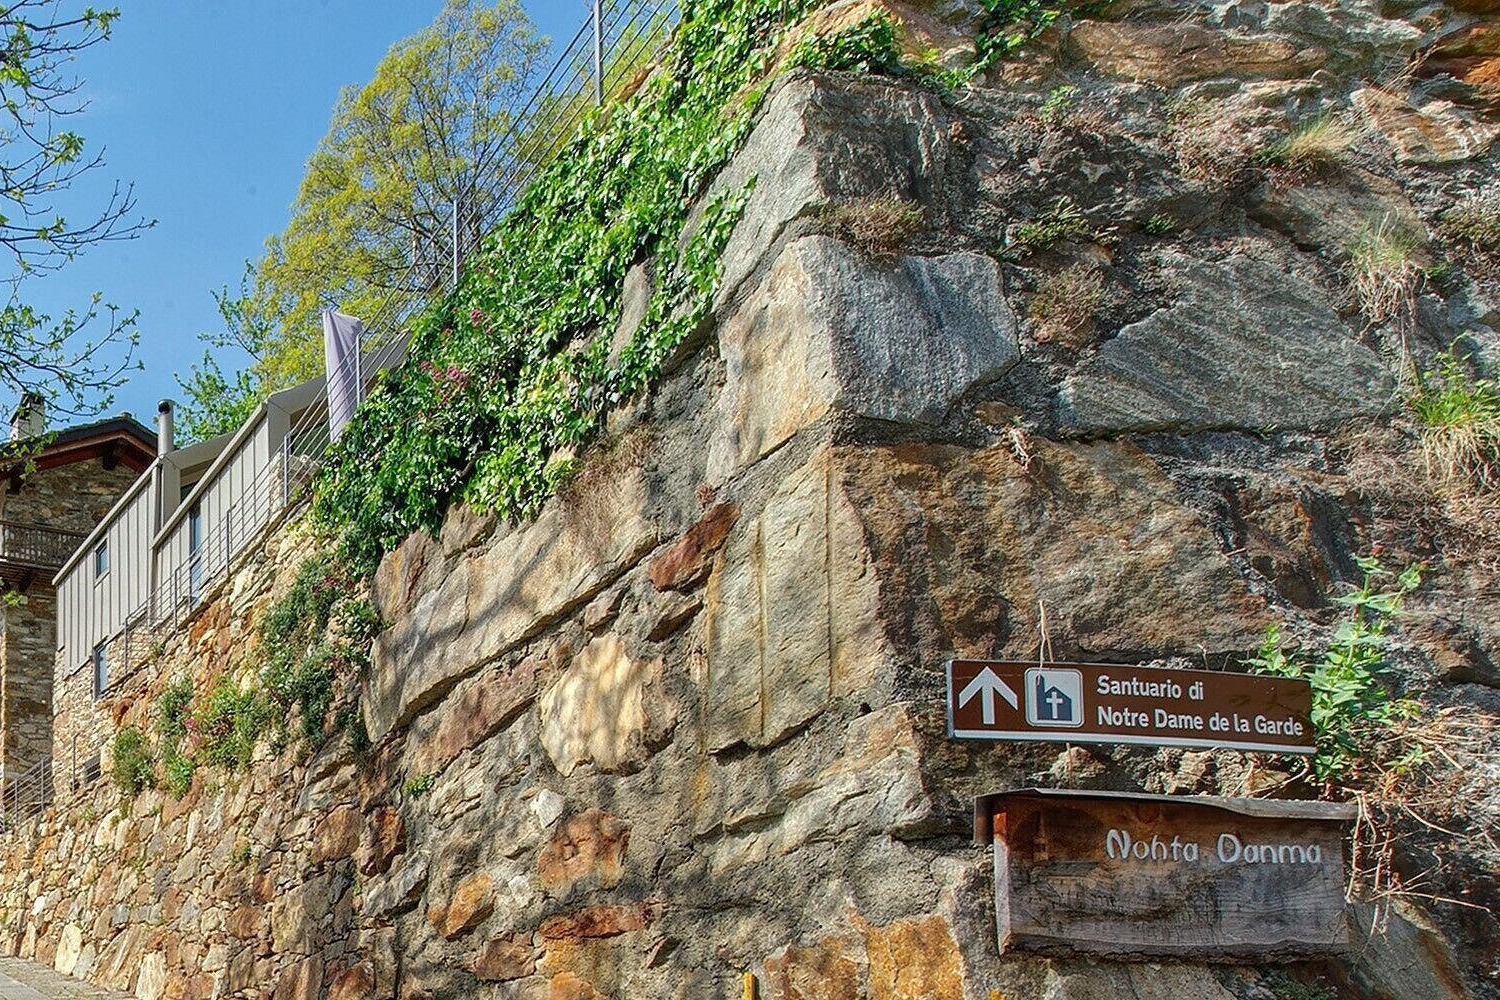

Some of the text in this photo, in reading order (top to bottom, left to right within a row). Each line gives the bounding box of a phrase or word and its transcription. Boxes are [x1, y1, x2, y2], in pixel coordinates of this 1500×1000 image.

[1097, 675, 1204, 700] Santuario di
[1098, 706, 1303, 736] Notre Dame de la Garde
